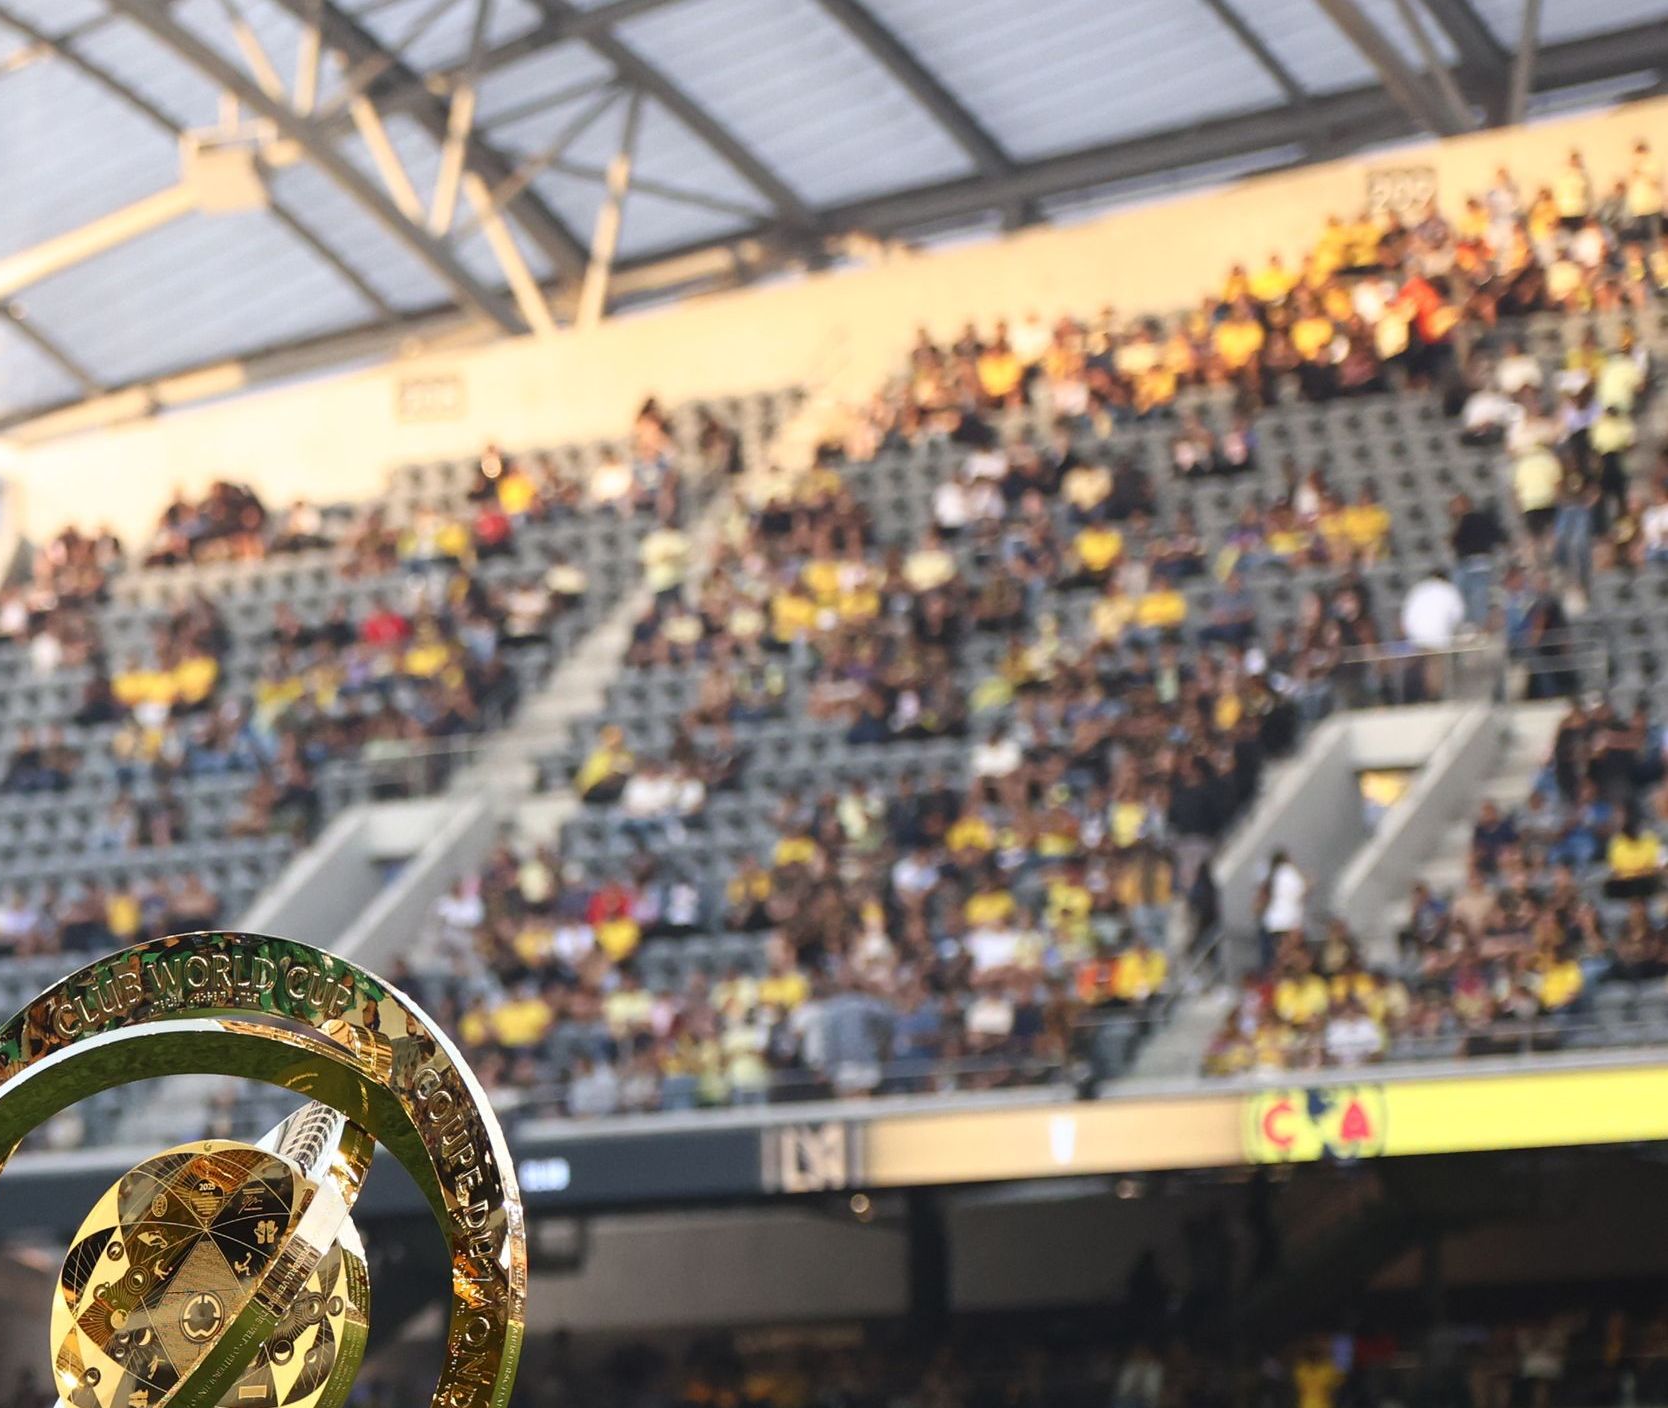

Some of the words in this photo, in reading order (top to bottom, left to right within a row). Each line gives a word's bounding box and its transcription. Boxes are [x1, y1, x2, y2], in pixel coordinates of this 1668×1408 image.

[53, 971, 143, 1040] CLUB
[146, 954, 279, 992] WORLD
[285, 965, 354, 1018] CUP
[414, 1067, 484, 1197] COUPE
